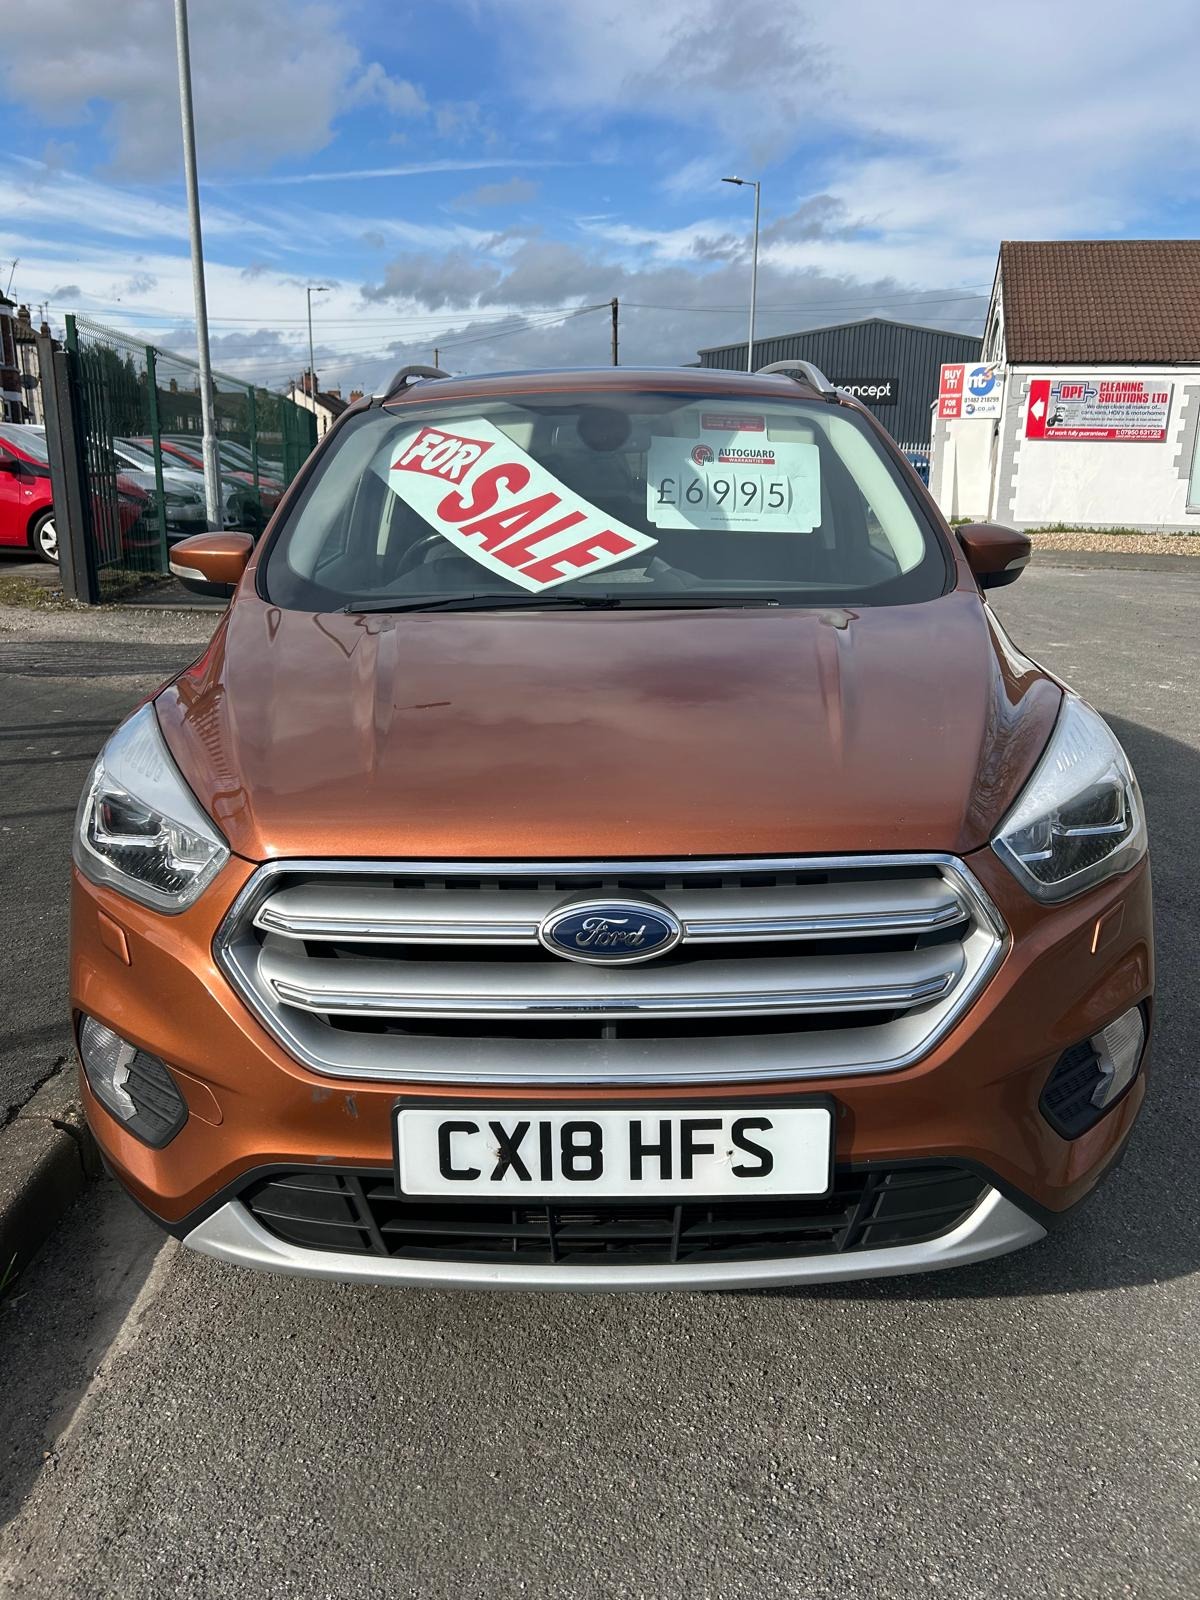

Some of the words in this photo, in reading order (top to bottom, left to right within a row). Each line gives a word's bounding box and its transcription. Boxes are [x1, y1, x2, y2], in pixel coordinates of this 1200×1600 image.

[944, 370, 962, 380] BUY
[1062, 386, 1083, 399] DPF
[1100, 382, 1144, 392] CLEANING
[945, 399, 957, 407] FOR
[1098, 393, 1149, 403] SOLUTIONS
[1151, 393, 1168, 403] LTD
[399, 432, 482, 480] FOR
[718, 448, 775, 458] AUTOGUARD
[436, 462, 637, 584] SALE
[575, 917, 647, 947] Ford
[438, 1119, 604, 1181] CX18
[628, 1117, 774, 1181] HFS
